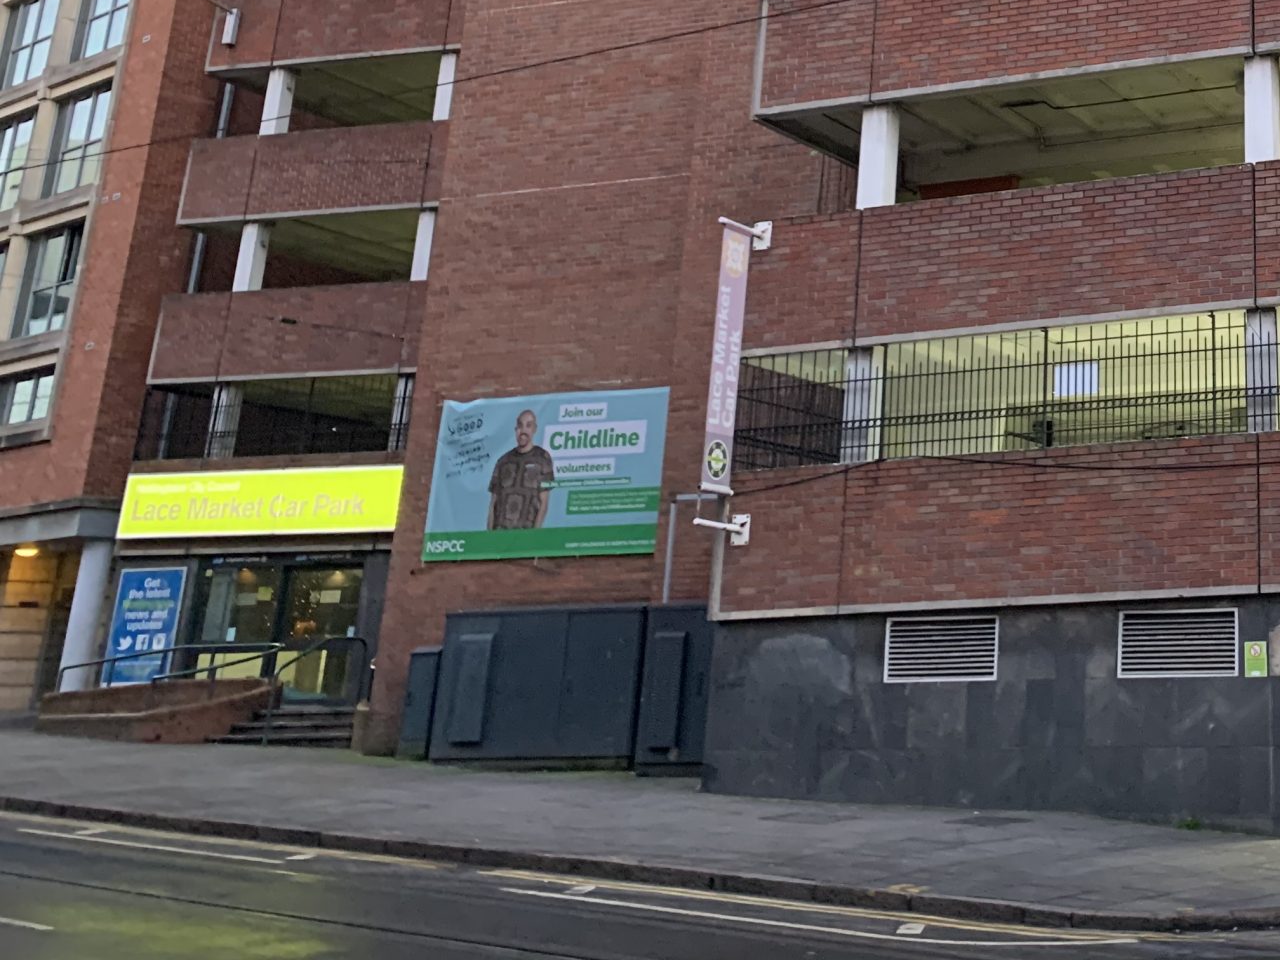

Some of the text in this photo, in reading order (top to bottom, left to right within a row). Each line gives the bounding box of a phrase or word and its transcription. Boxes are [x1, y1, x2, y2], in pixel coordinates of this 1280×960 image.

[708, 286, 731, 425] Lace Market
[721, 330, 741, 428] Car Park
[562, 407, 604, 418] Join our
[549, 428, 640, 450] Childline
[556, 463, 611, 474] volunteers
[131, 494, 365, 522] Lace Market Car Park
[426, 540, 465, 553] NSPCC
